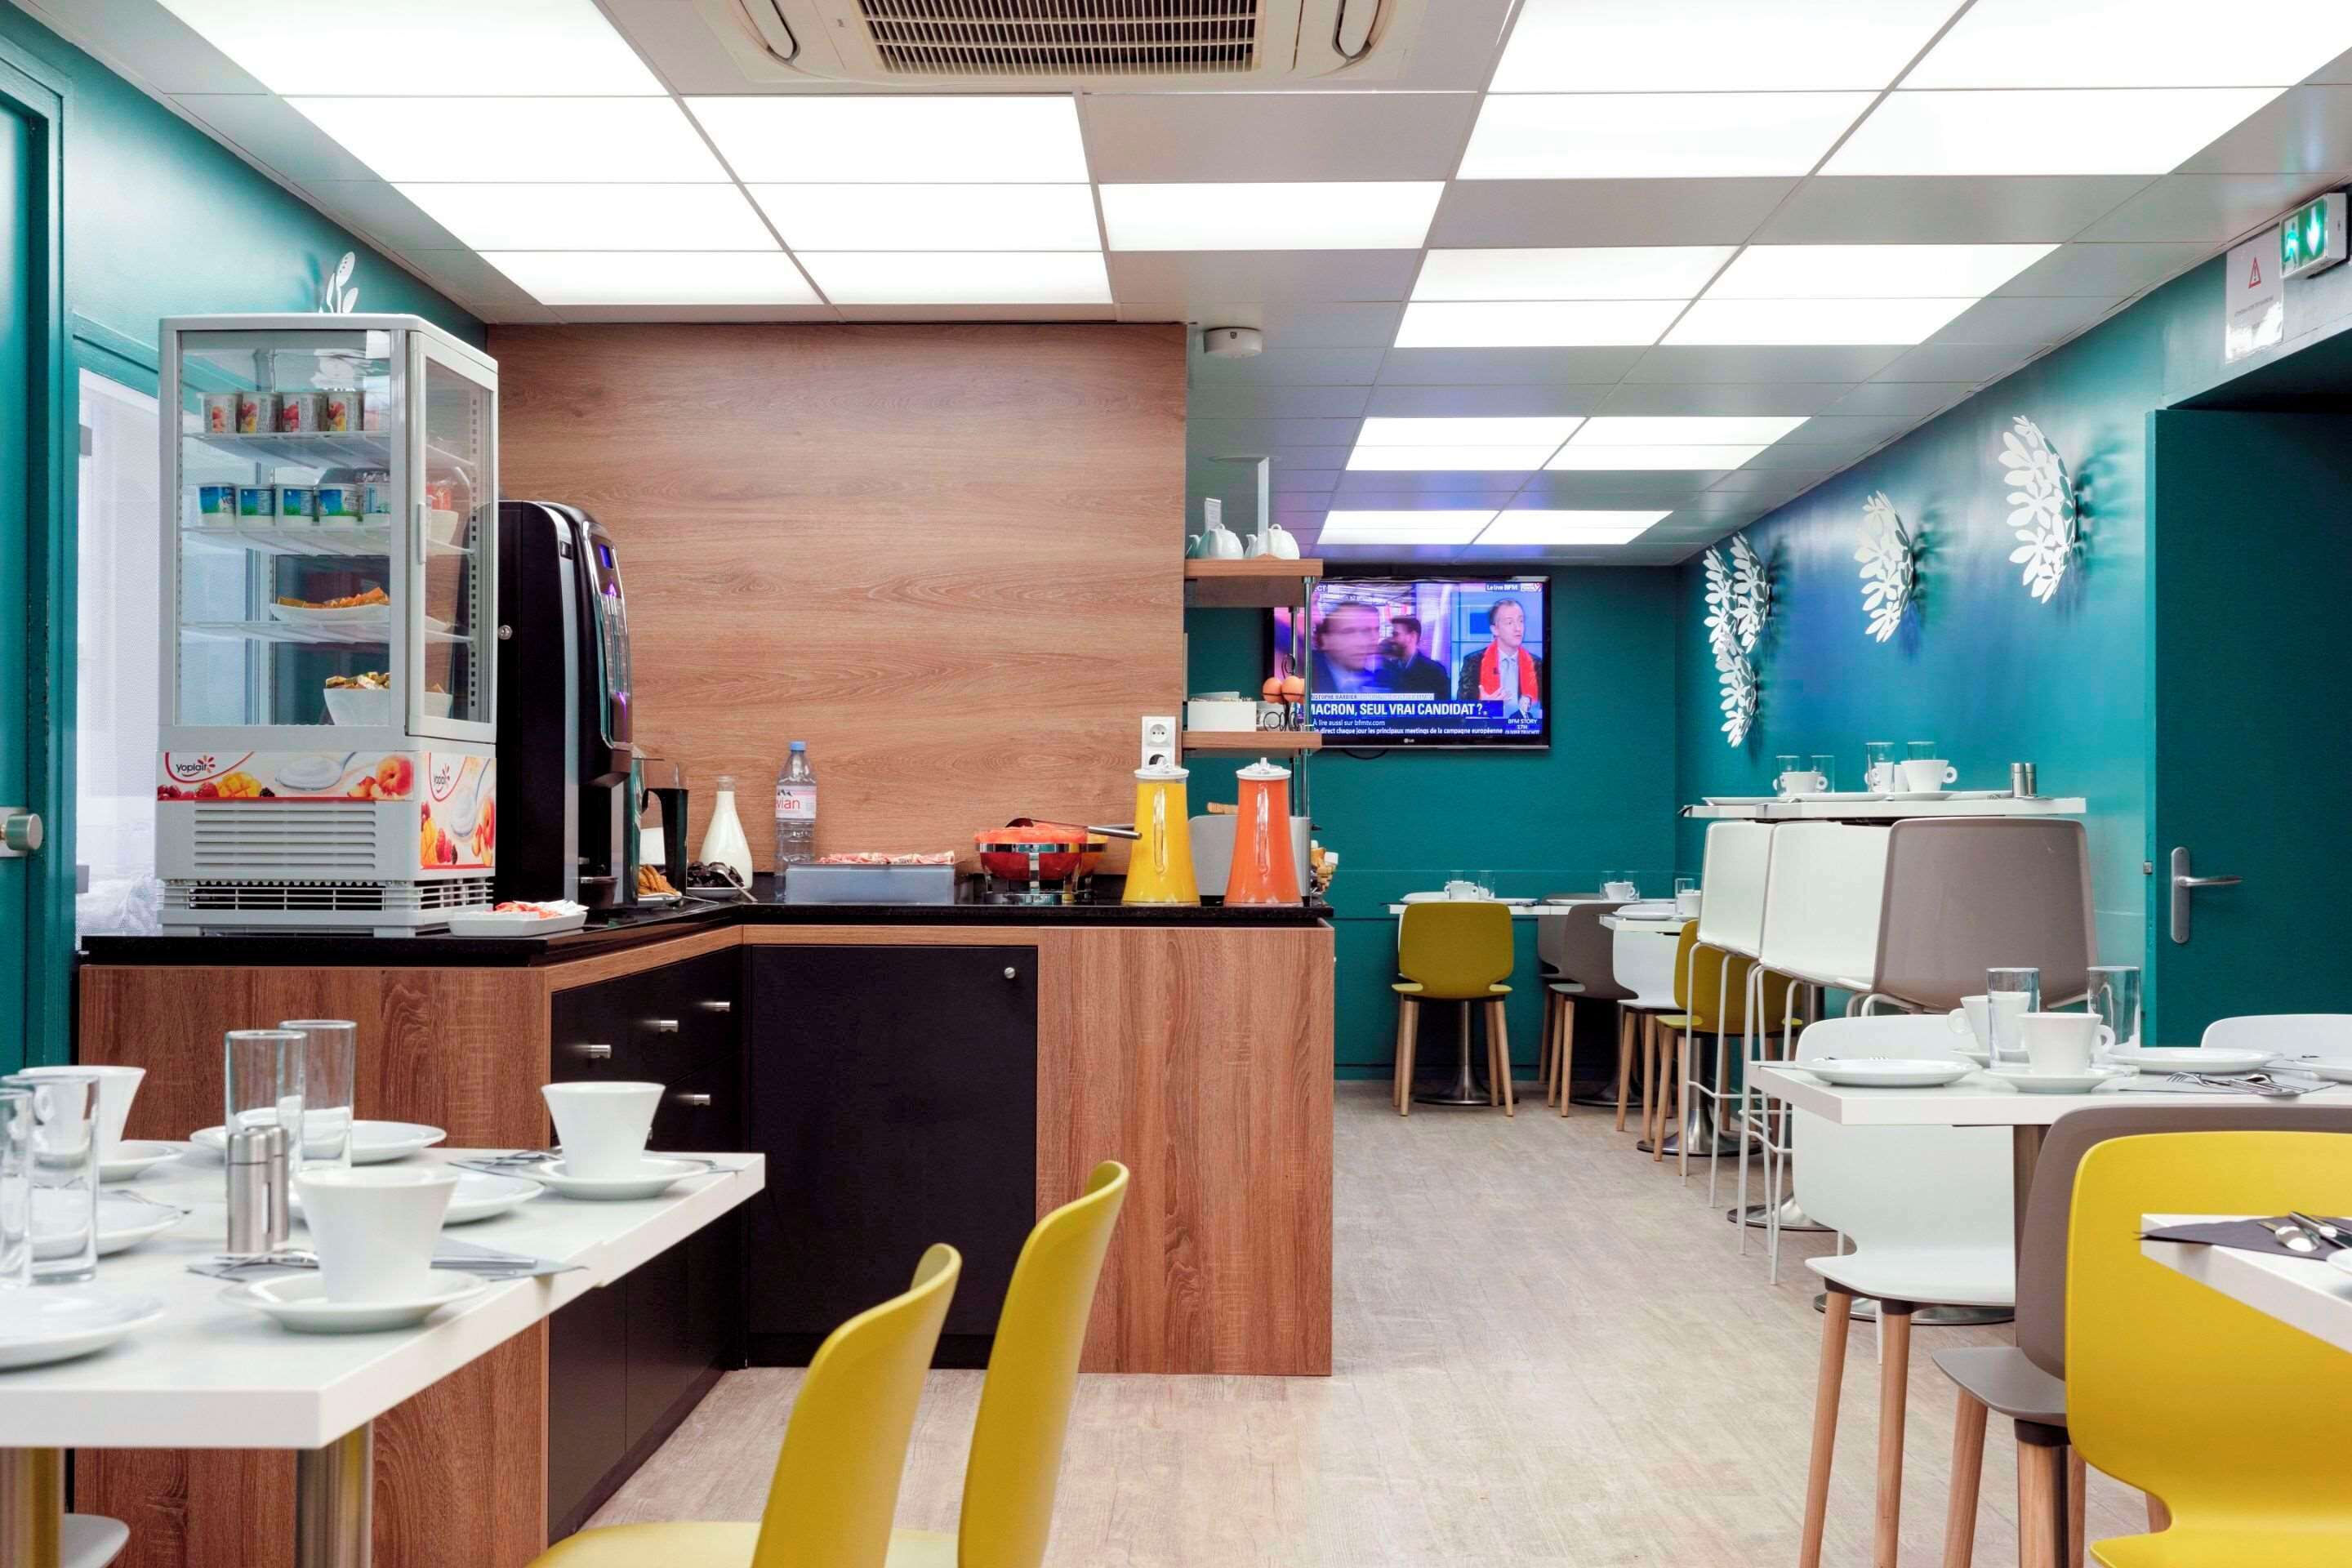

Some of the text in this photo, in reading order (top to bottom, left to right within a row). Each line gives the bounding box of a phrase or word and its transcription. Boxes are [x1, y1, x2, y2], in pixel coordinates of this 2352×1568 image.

[1359, 703, 1388, 715] SEUL
[1388, 703, 1415, 715] VRAI
[1417, 703, 1475, 715] CANDIDAT
[1336, 727, 1356, 735] chaque
[1356, 727, 1367, 735] jour
[1376, 727, 1404, 735] principaux
[1405, 727, 1429, 735] meetings
[1472, 727, 1503, 735] européenne
[775, 799, 801, 810] vian
